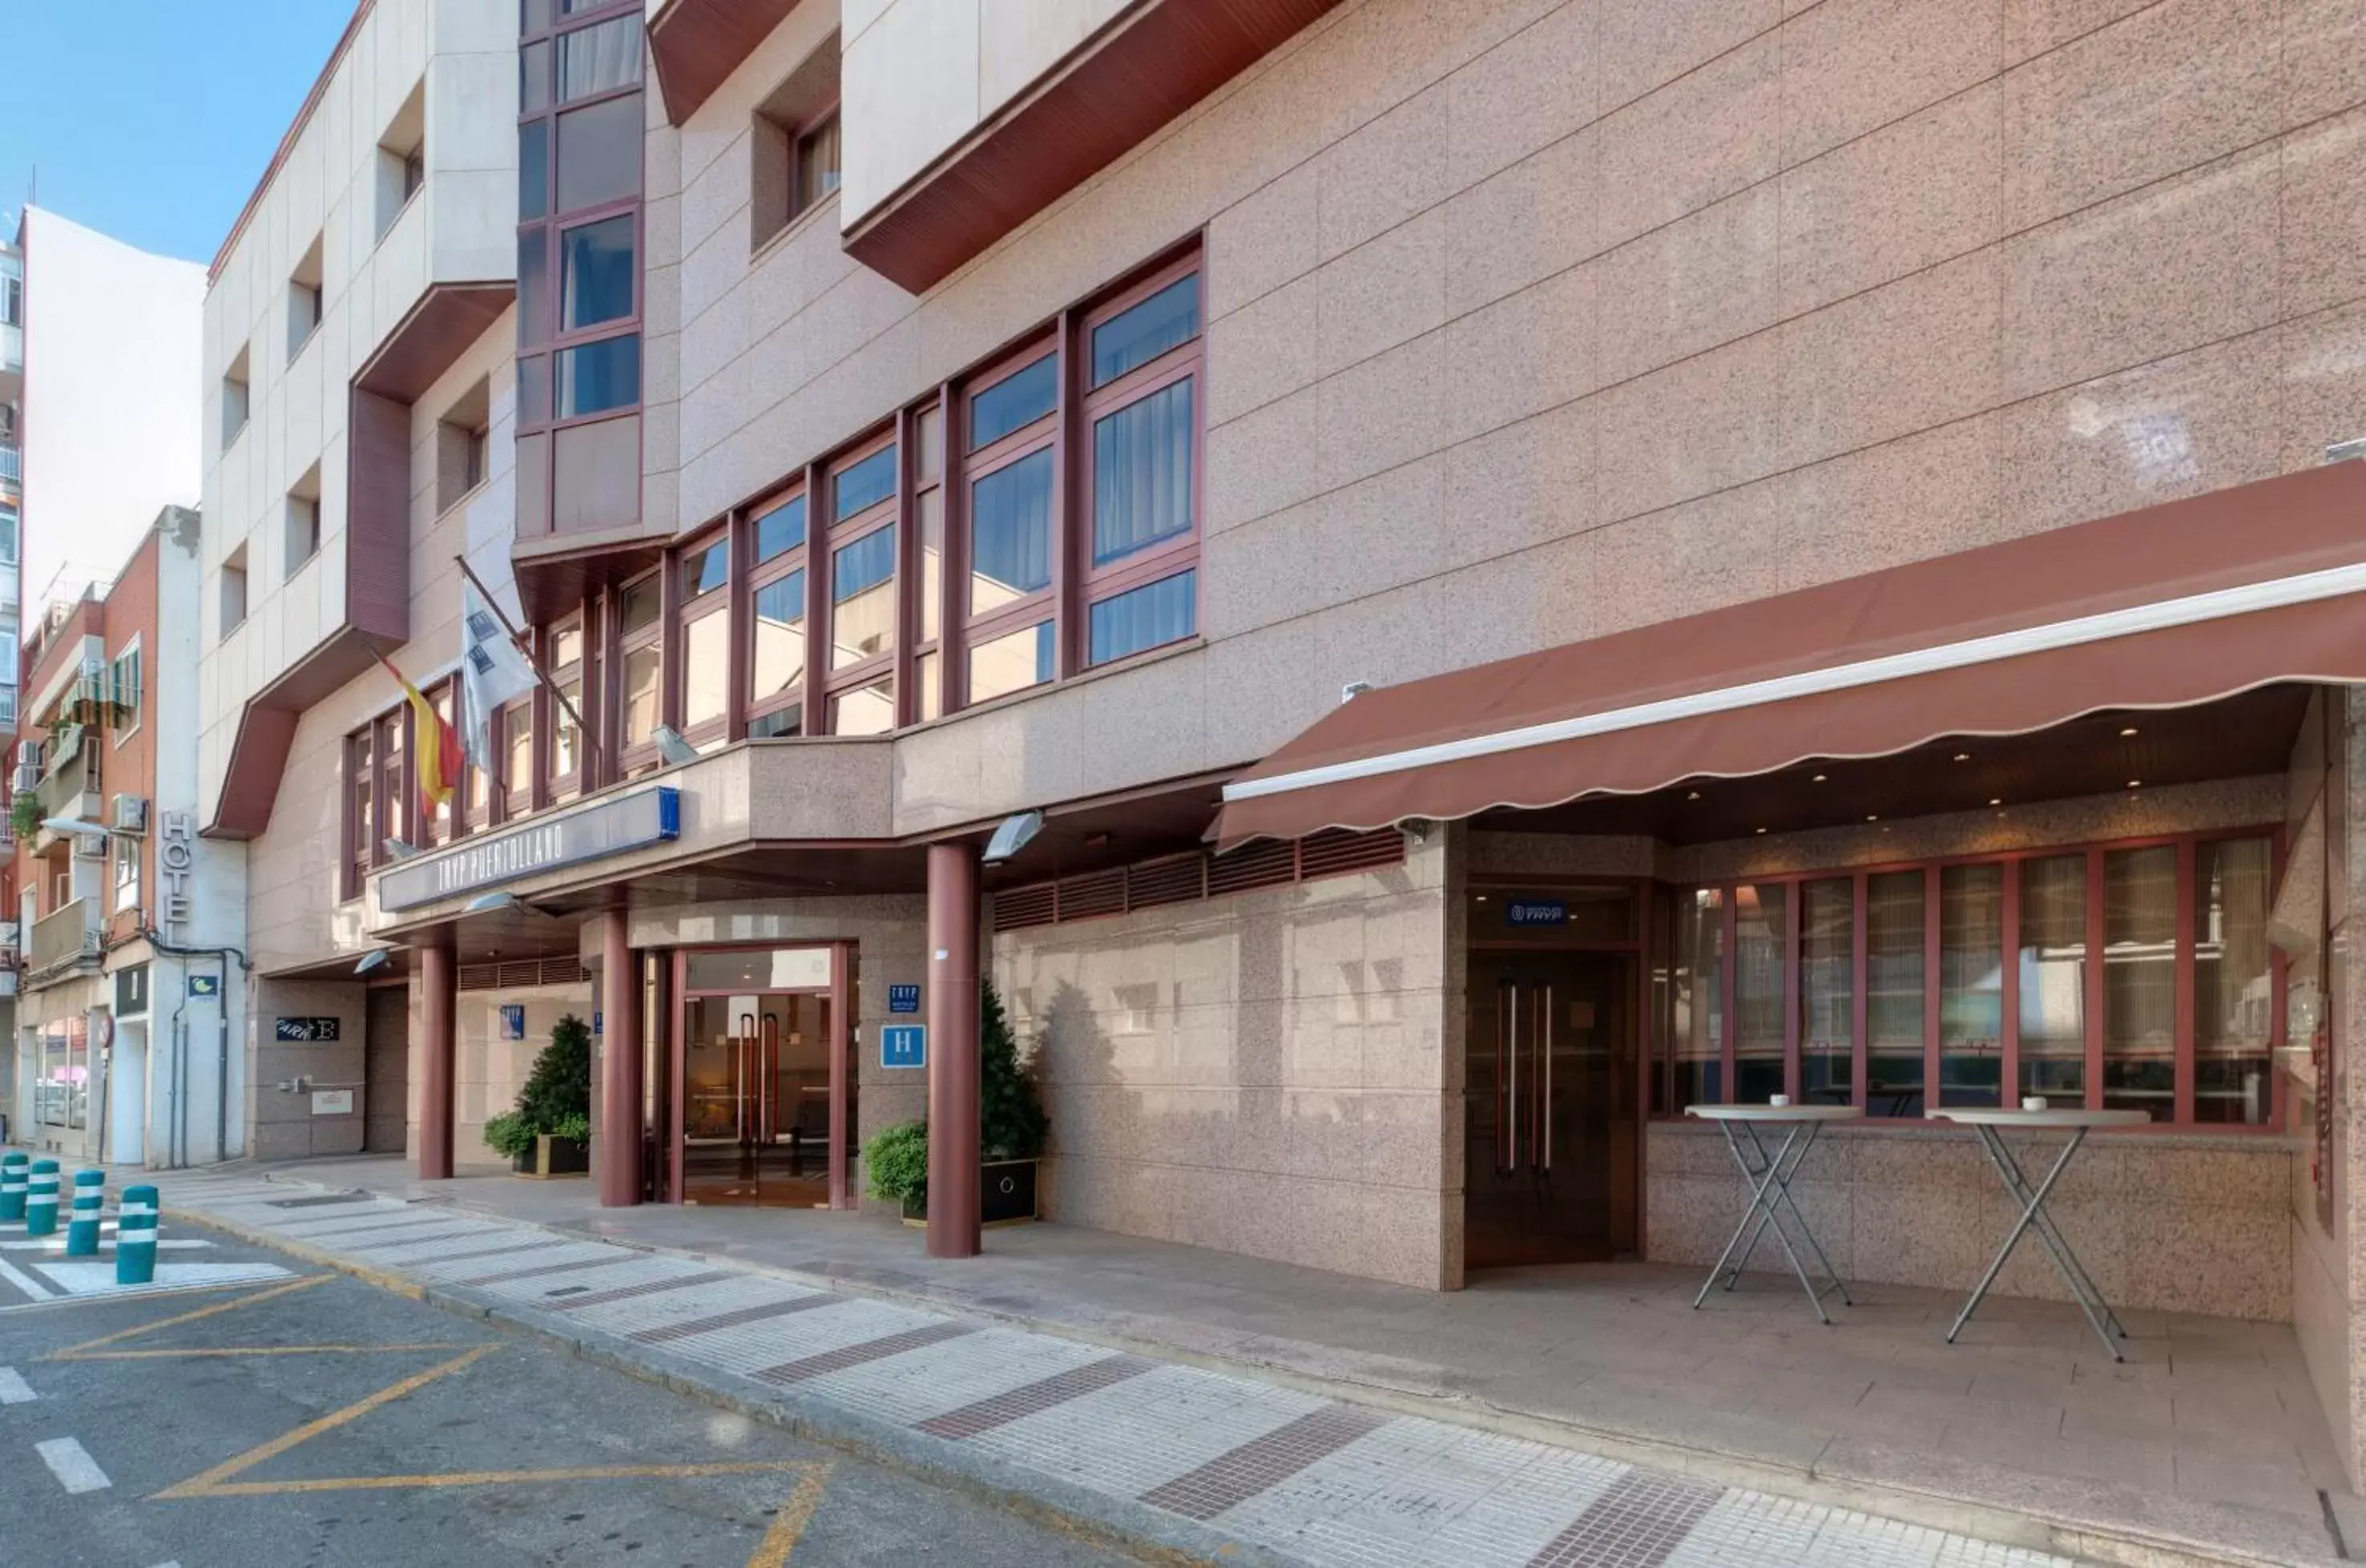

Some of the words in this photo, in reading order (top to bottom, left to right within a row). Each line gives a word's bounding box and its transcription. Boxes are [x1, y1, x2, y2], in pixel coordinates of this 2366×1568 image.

[163, 808, 190, 947] HOTEL
[439, 855, 466, 892] TRYP
[471, 824, 562, 882] PUERTOLLANO
[895, 1031, 911, 1053] H
